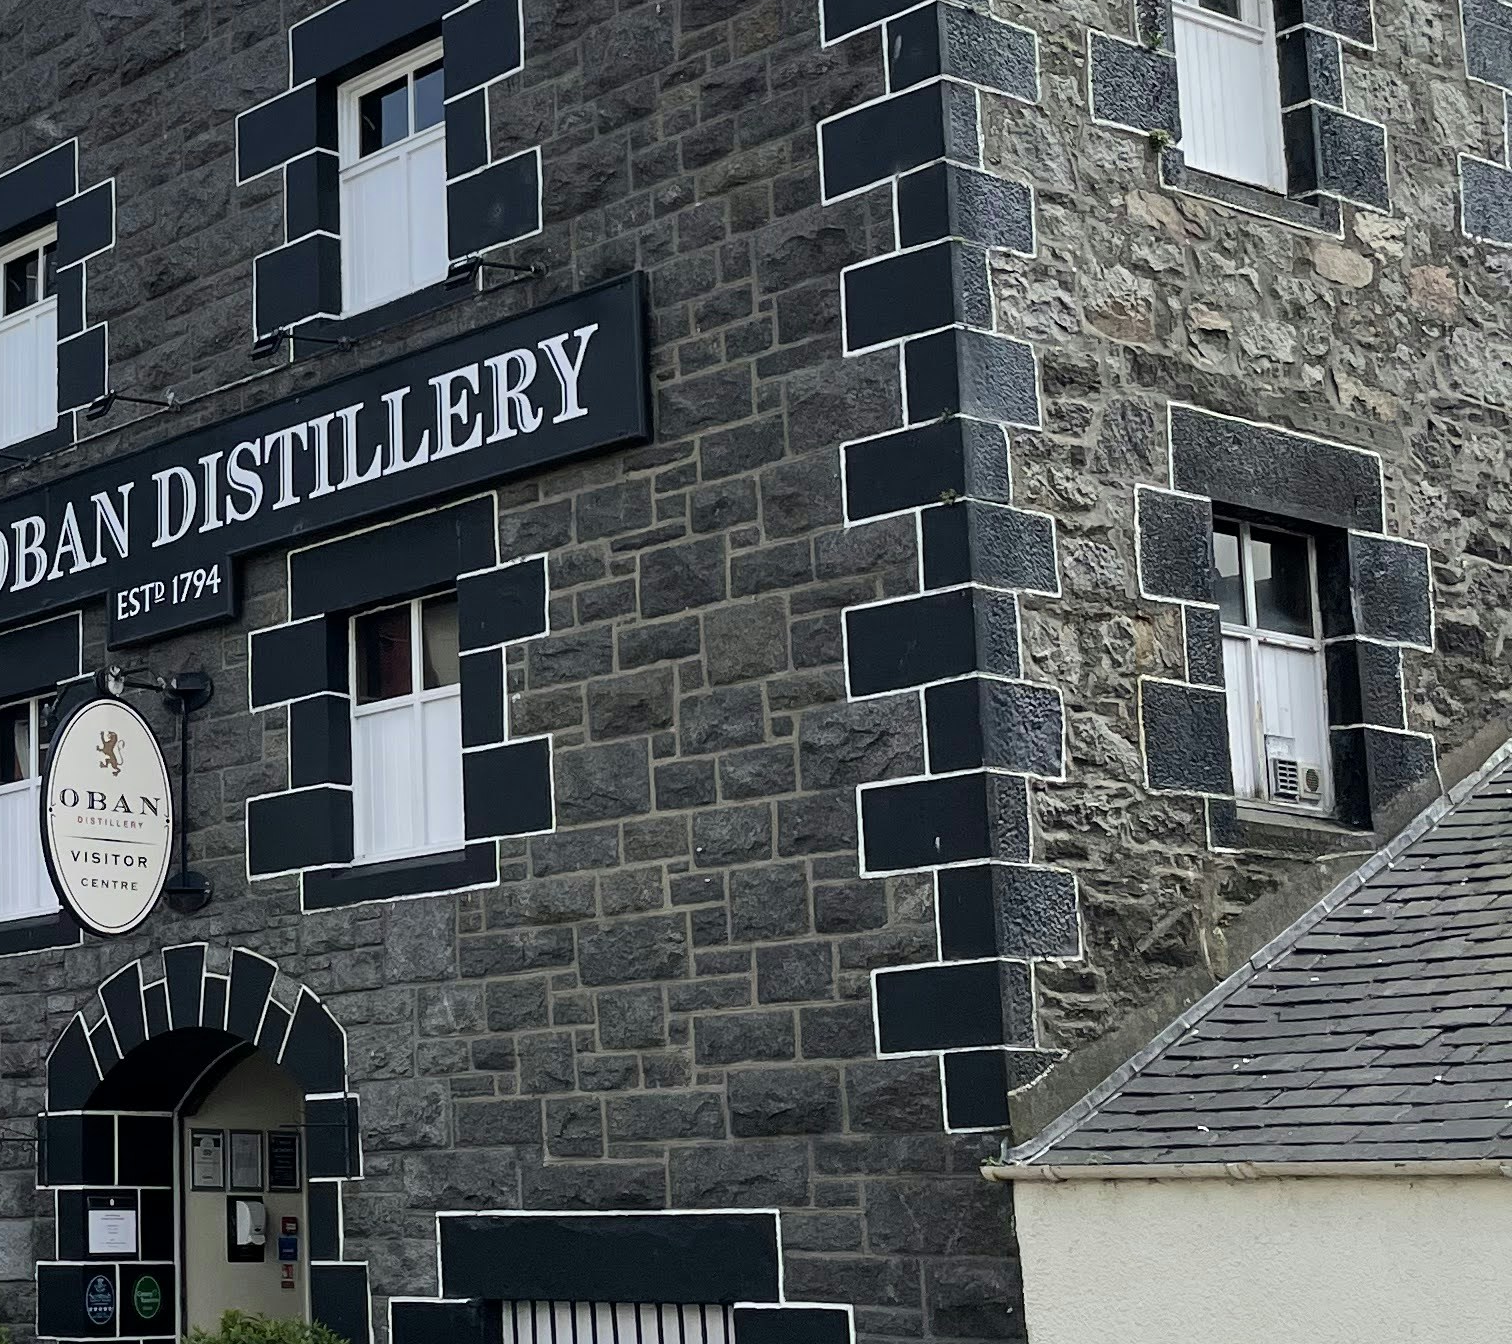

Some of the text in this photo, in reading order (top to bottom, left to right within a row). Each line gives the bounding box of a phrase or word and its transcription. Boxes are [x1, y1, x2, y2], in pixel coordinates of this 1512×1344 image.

[151, 323, 599, 548] DISTILLERY
[172, 564, 222, 604] 1794
[59, 788, 161, 817] OBAN
[77, 815, 144, 829] DISTILLERY
[71, 850, 148, 868] VISITOR
[80, 877, 139, 891] CENTRE
